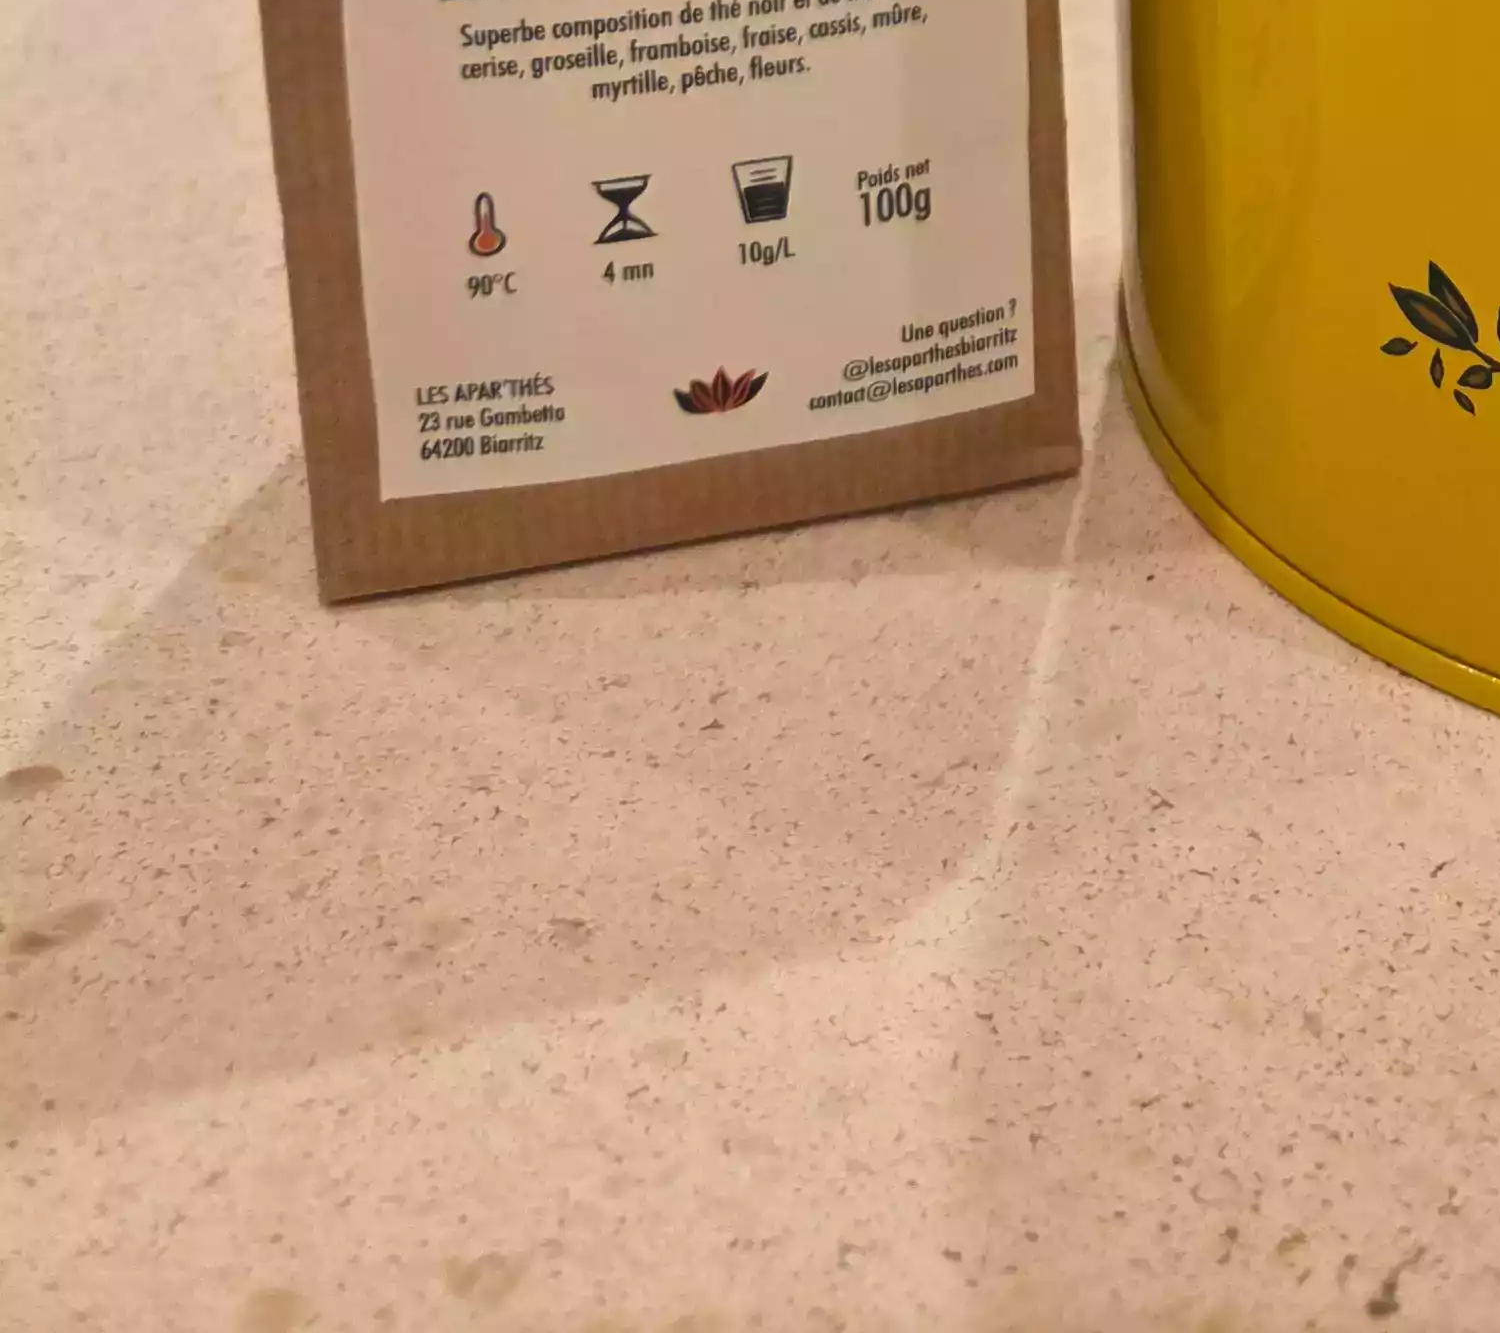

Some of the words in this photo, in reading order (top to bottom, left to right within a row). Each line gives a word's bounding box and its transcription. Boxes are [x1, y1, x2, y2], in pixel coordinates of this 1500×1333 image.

[460, 16, 546, 50] Superbe
[552, 7, 672, 40] composition
[680, 0, 704, 25] de
[461, 56, 525, 79] cerise,
[531, 43, 624, 79] groseille,
[630, 32, 737, 63] framboise,
[742, 24, 804, 49] fraise,
[809, 11, 866, 39] cassis,
[872, 2, 928, 29] mûre,
[592, 70, 675, 103] myrtille,
[681, 59, 744, 94] pêche,
[749, 55, 811, 80] fleurs.
[856, 165, 900, 191] Poids
[905, 158, 930, 181] net
[858, 181, 931, 227] 100g
[737, 237, 796, 266] 10g/L
[467, 270, 518, 300] 90°C
[602, 261, 616, 282] 4
[622, 261, 655, 281] mn
[901, 323, 934, 343] Une
[938, 305, 1004, 338] question
[843, 327, 1018, 381] @lesaparthesbiarritz
[416, 385, 449, 406] LES
[809, 354, 1019, 411] contact@lesaparthes.com
[419, 411, 440, 433] 23
[446, 414, 475, 430] rue
[480, 404, 565, 427] Gambetta
[420, 436, 474, 460] 64200
[480, 432, 544, 456] Biarritz
